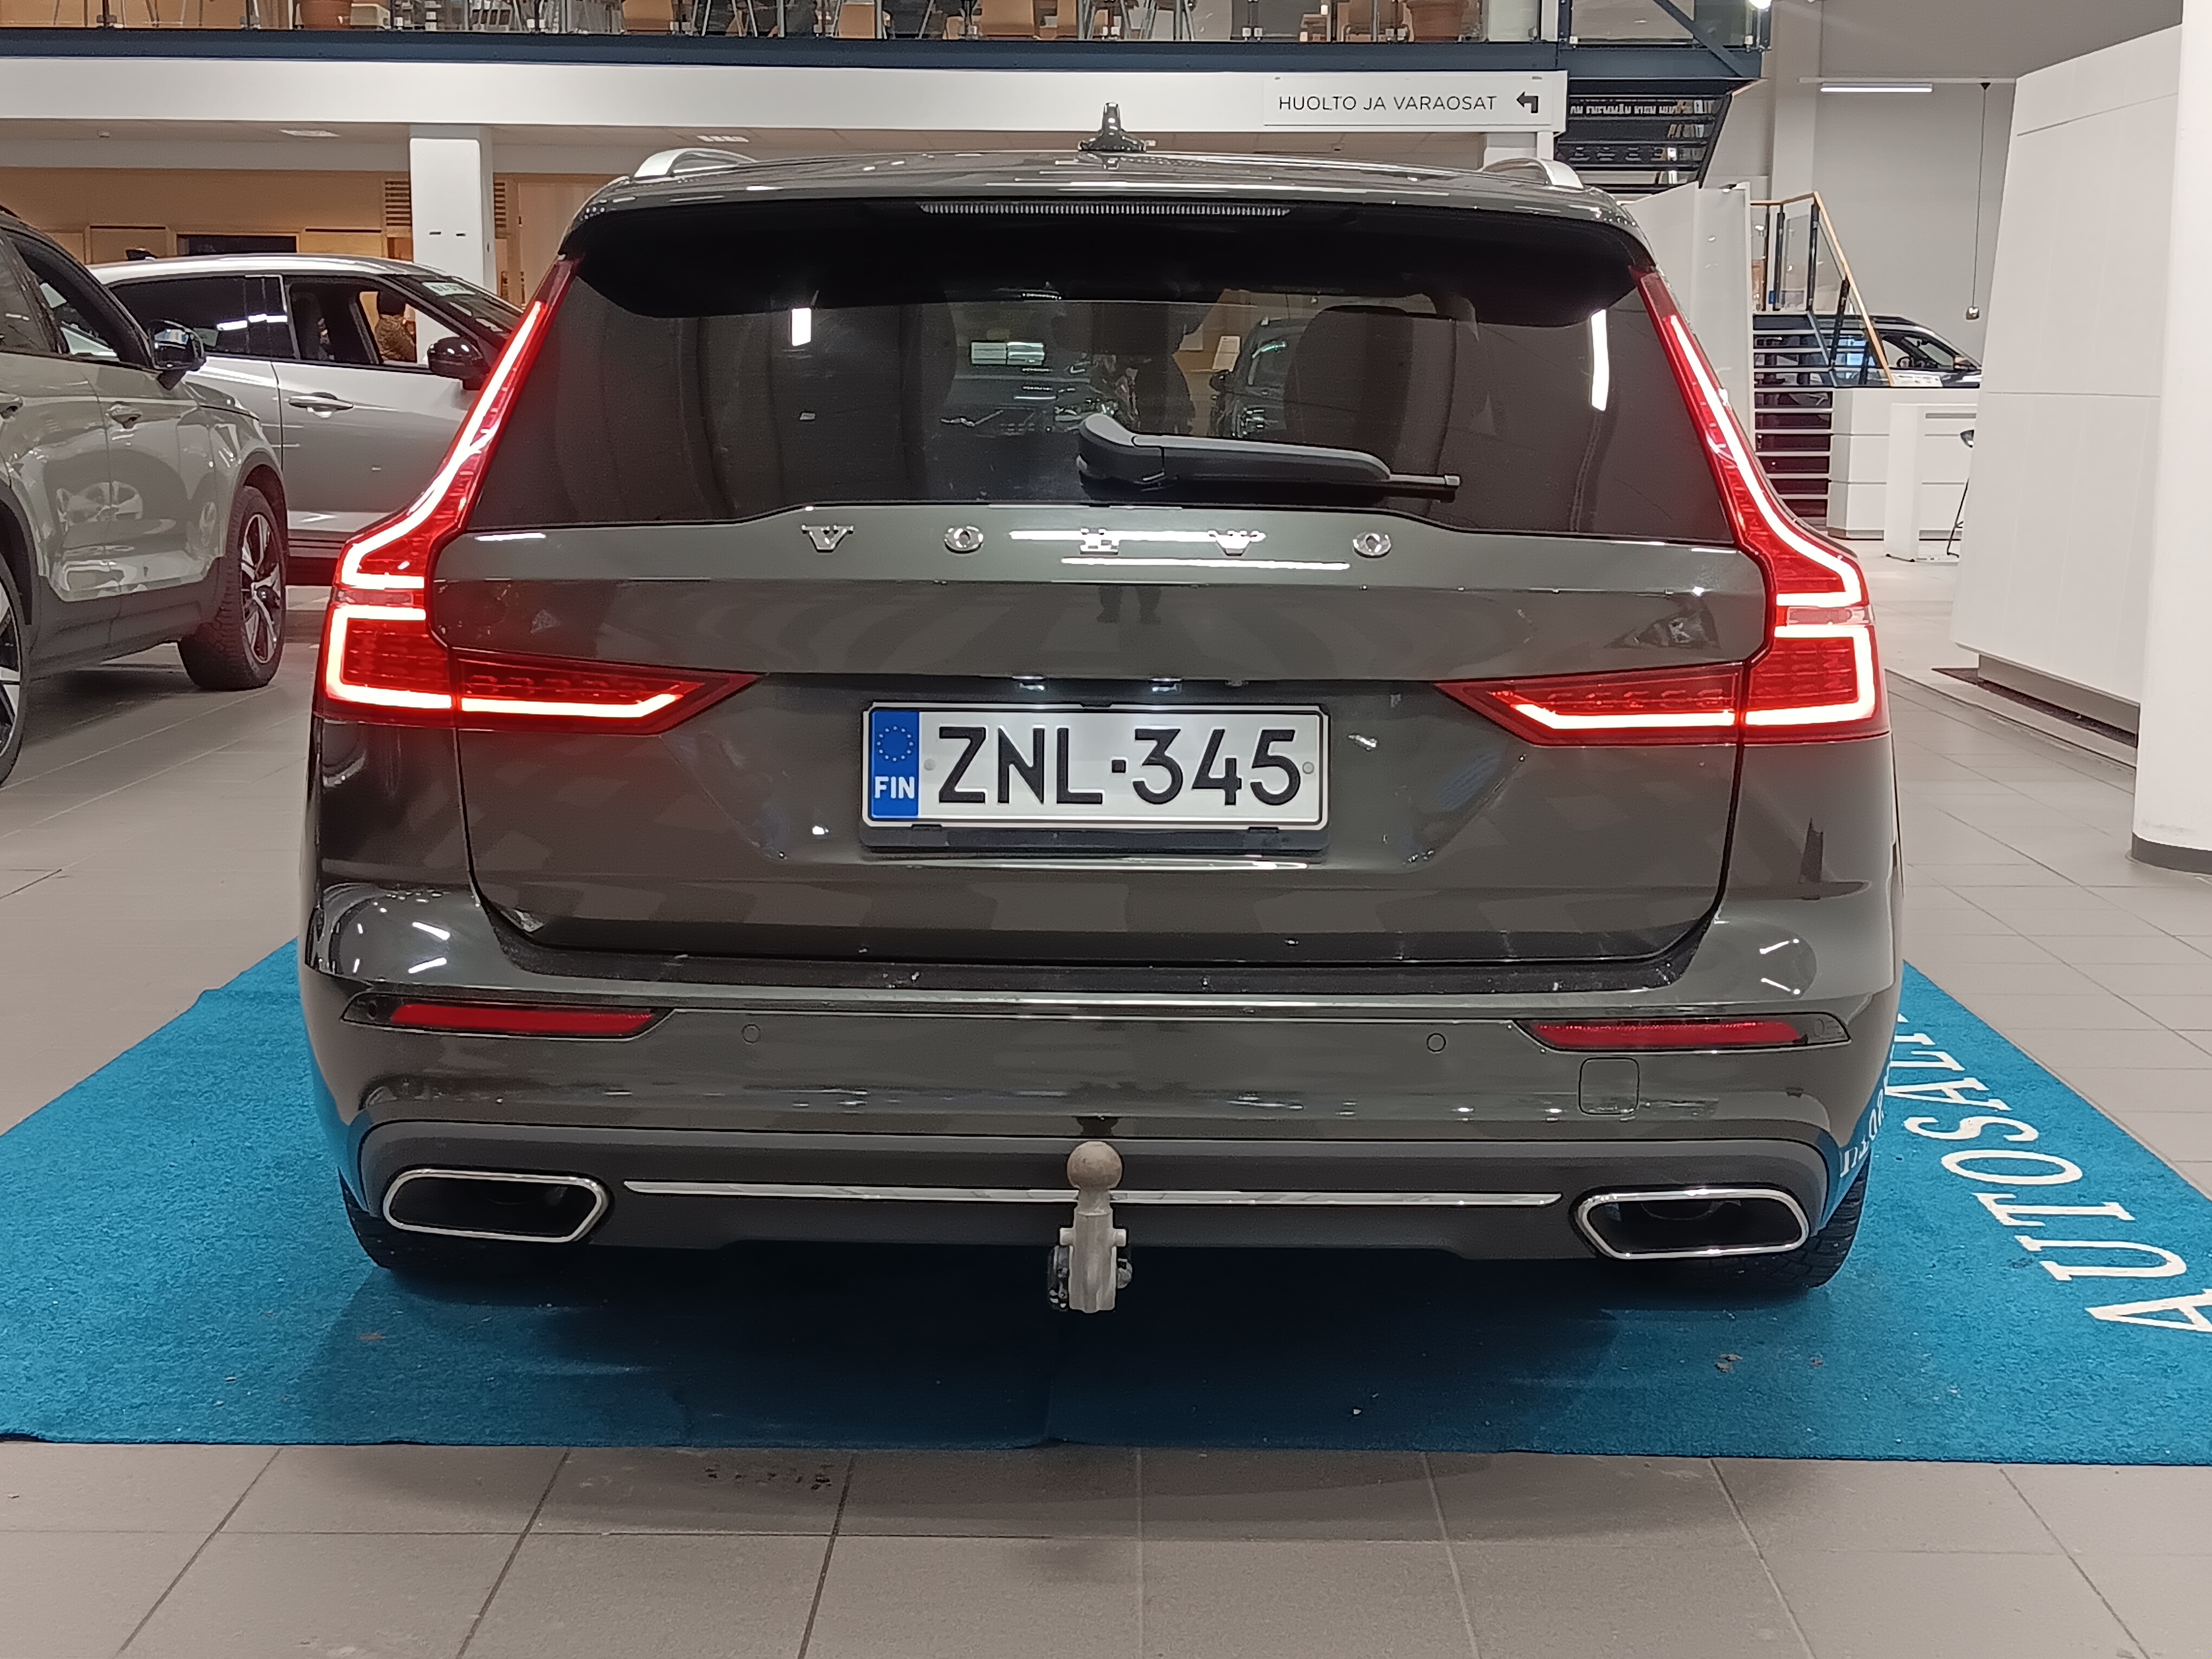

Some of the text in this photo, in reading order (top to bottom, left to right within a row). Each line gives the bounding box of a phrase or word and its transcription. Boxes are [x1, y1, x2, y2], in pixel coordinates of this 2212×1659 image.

[1278, 95, 1497, 111] HUOLTO JA VARAOSAT
[874, 776, 915, 799] FIN
[1883, 1013, 2212, 1333] AUTOSAL
